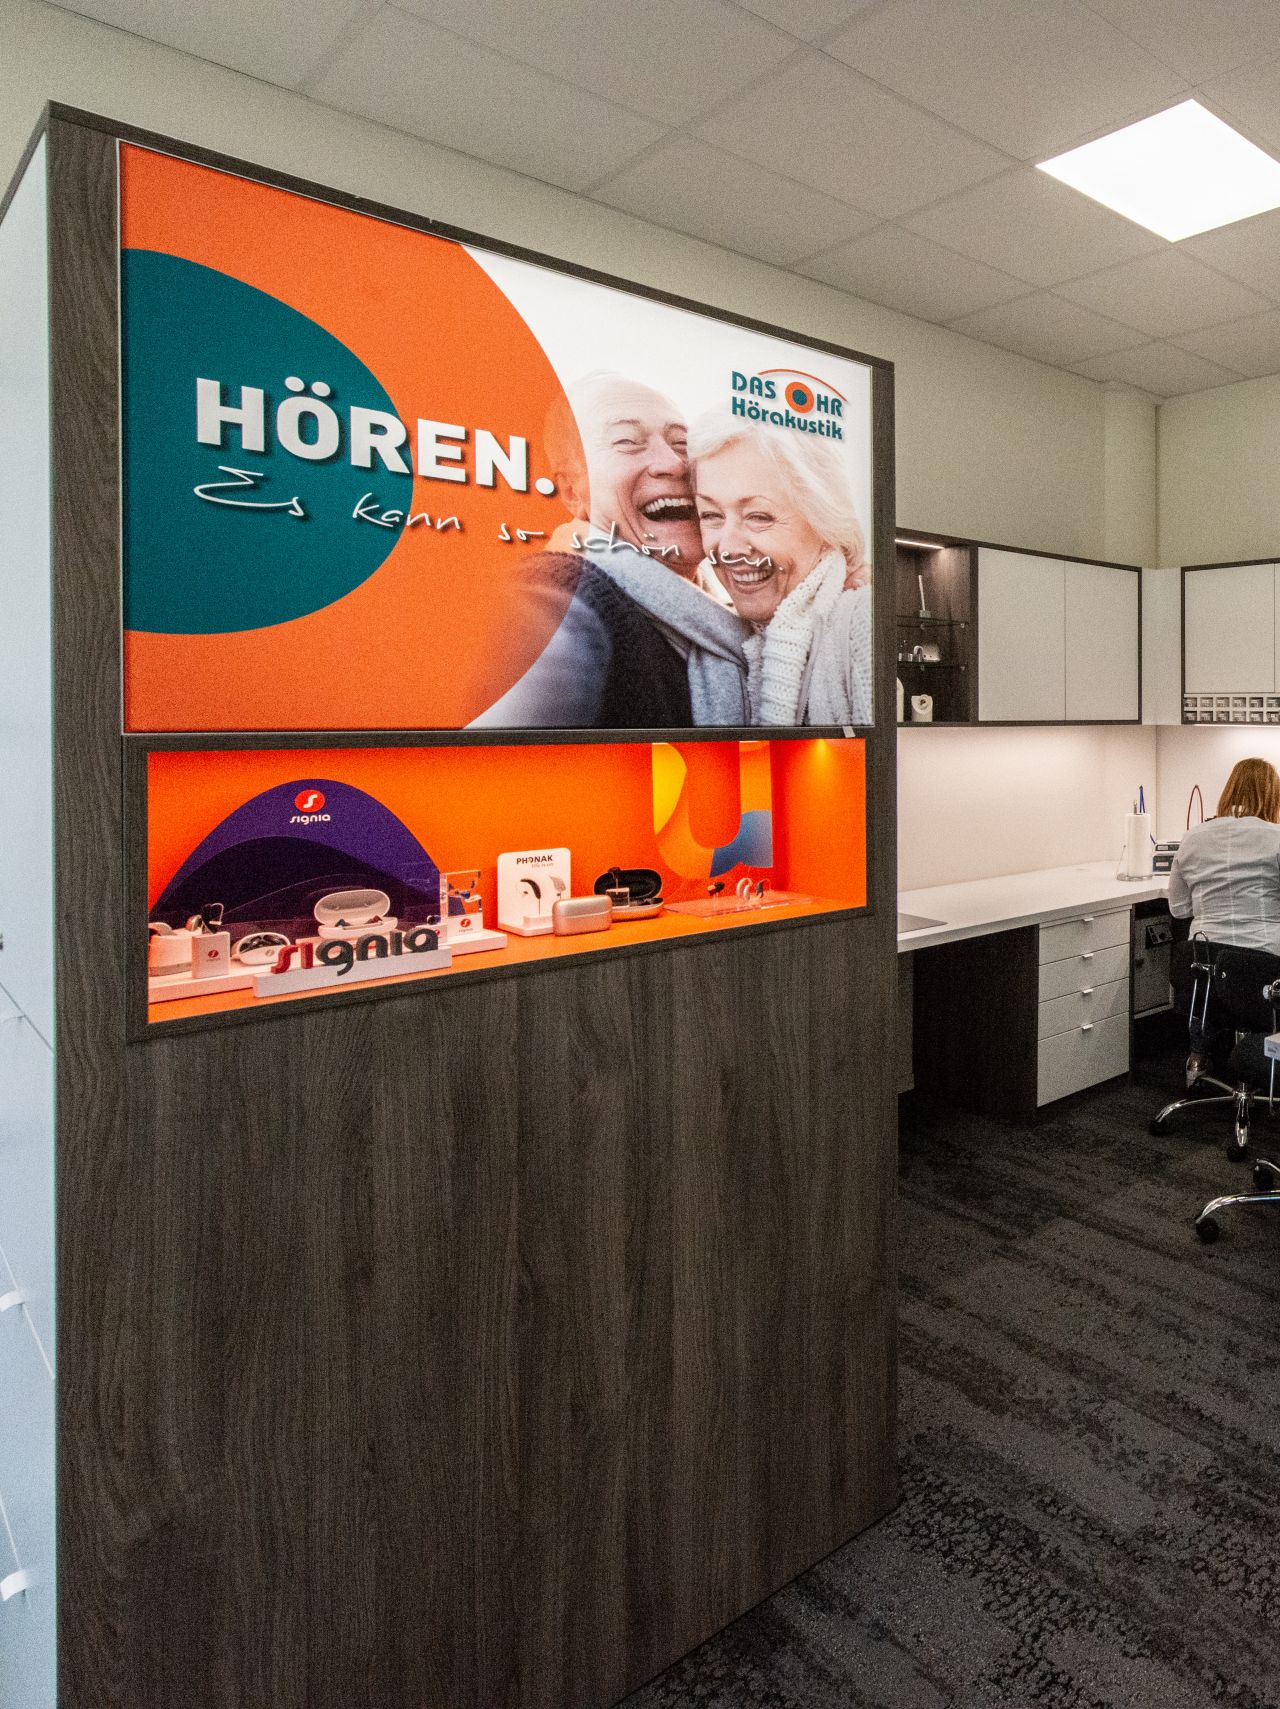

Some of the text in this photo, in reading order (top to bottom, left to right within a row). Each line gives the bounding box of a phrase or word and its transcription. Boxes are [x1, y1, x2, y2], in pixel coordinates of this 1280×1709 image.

[731, 370, 777, 400] DAS
[196, 376, 555, 496] HÖREN.
[731, 396, 843, 440] Hörakustik
[193, 465, 785, 572] Es kann so schön sein.
[289, 814, 331, 826] signia
[516, 854, 553, 865] PHONAK
[270, 928, 439, 977] signia
